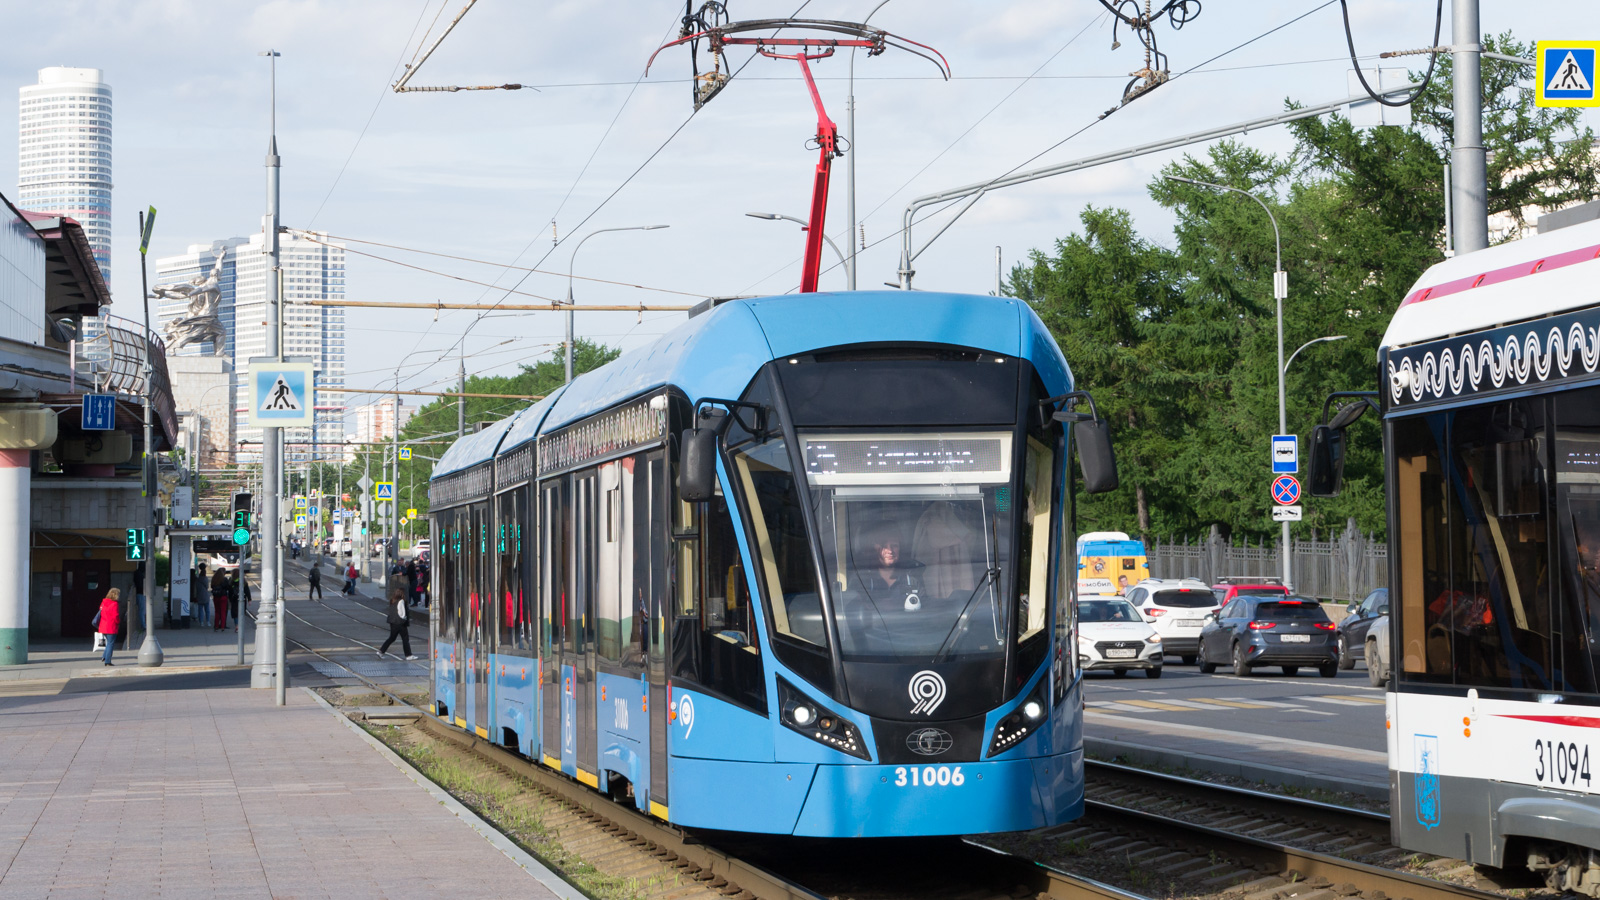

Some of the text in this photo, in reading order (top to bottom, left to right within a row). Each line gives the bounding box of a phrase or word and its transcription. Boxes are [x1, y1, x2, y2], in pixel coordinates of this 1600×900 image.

[237, 512, 251, 527] 31
[128, 529, 145, 545] 31
[614, 697, 629, 731] 31006
[1535, 739, 1591, 787] 31094
[895, 767, 965, 786] 31006
